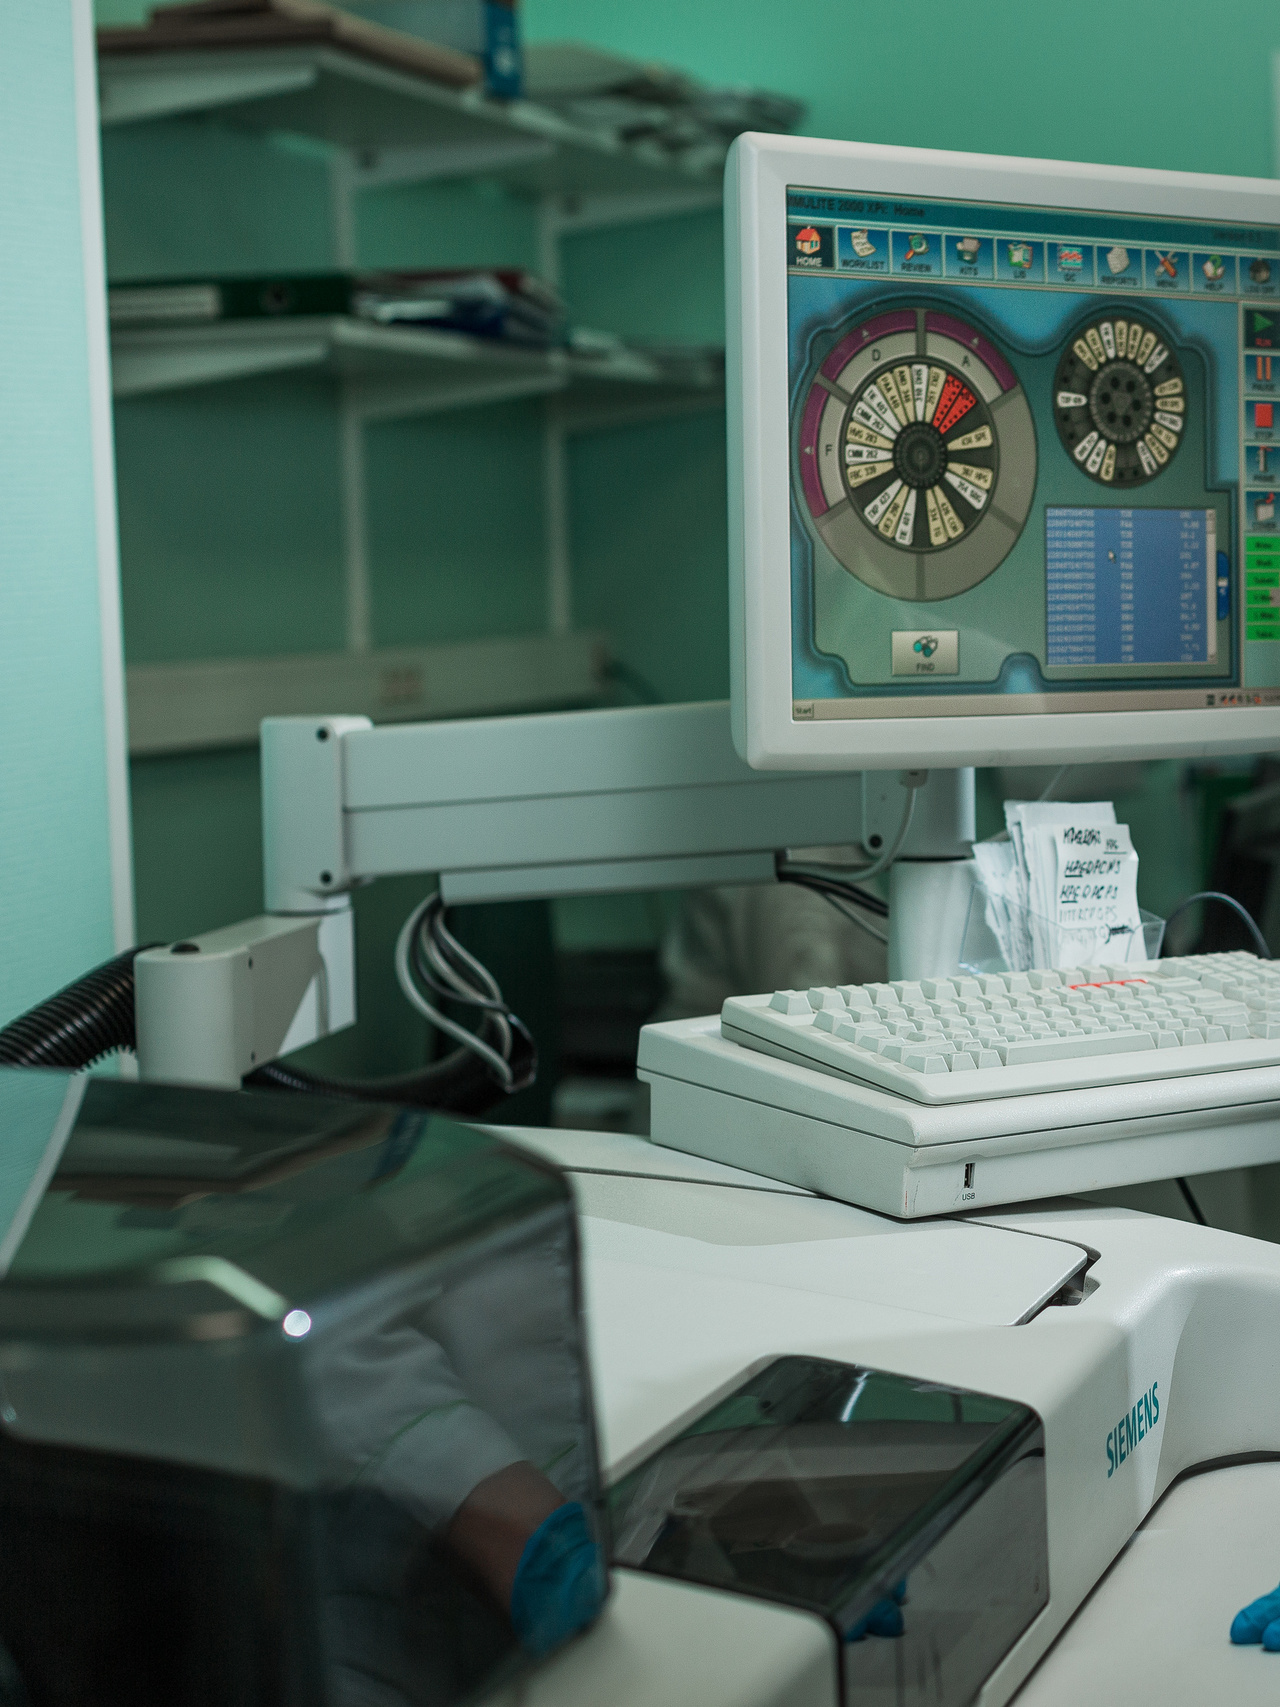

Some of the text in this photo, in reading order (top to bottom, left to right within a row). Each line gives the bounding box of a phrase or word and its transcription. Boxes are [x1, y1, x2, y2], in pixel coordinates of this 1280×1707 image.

[796, 257, 822, 267] HOME
[841, 259, 885, 270] WORKLIST
[872, 349, 881, 361] D
[962, 354, 971, 367] A
[962, 1192, 976, 1201] USB
[1106, 1381, 1160, 1479] SIEMENS
